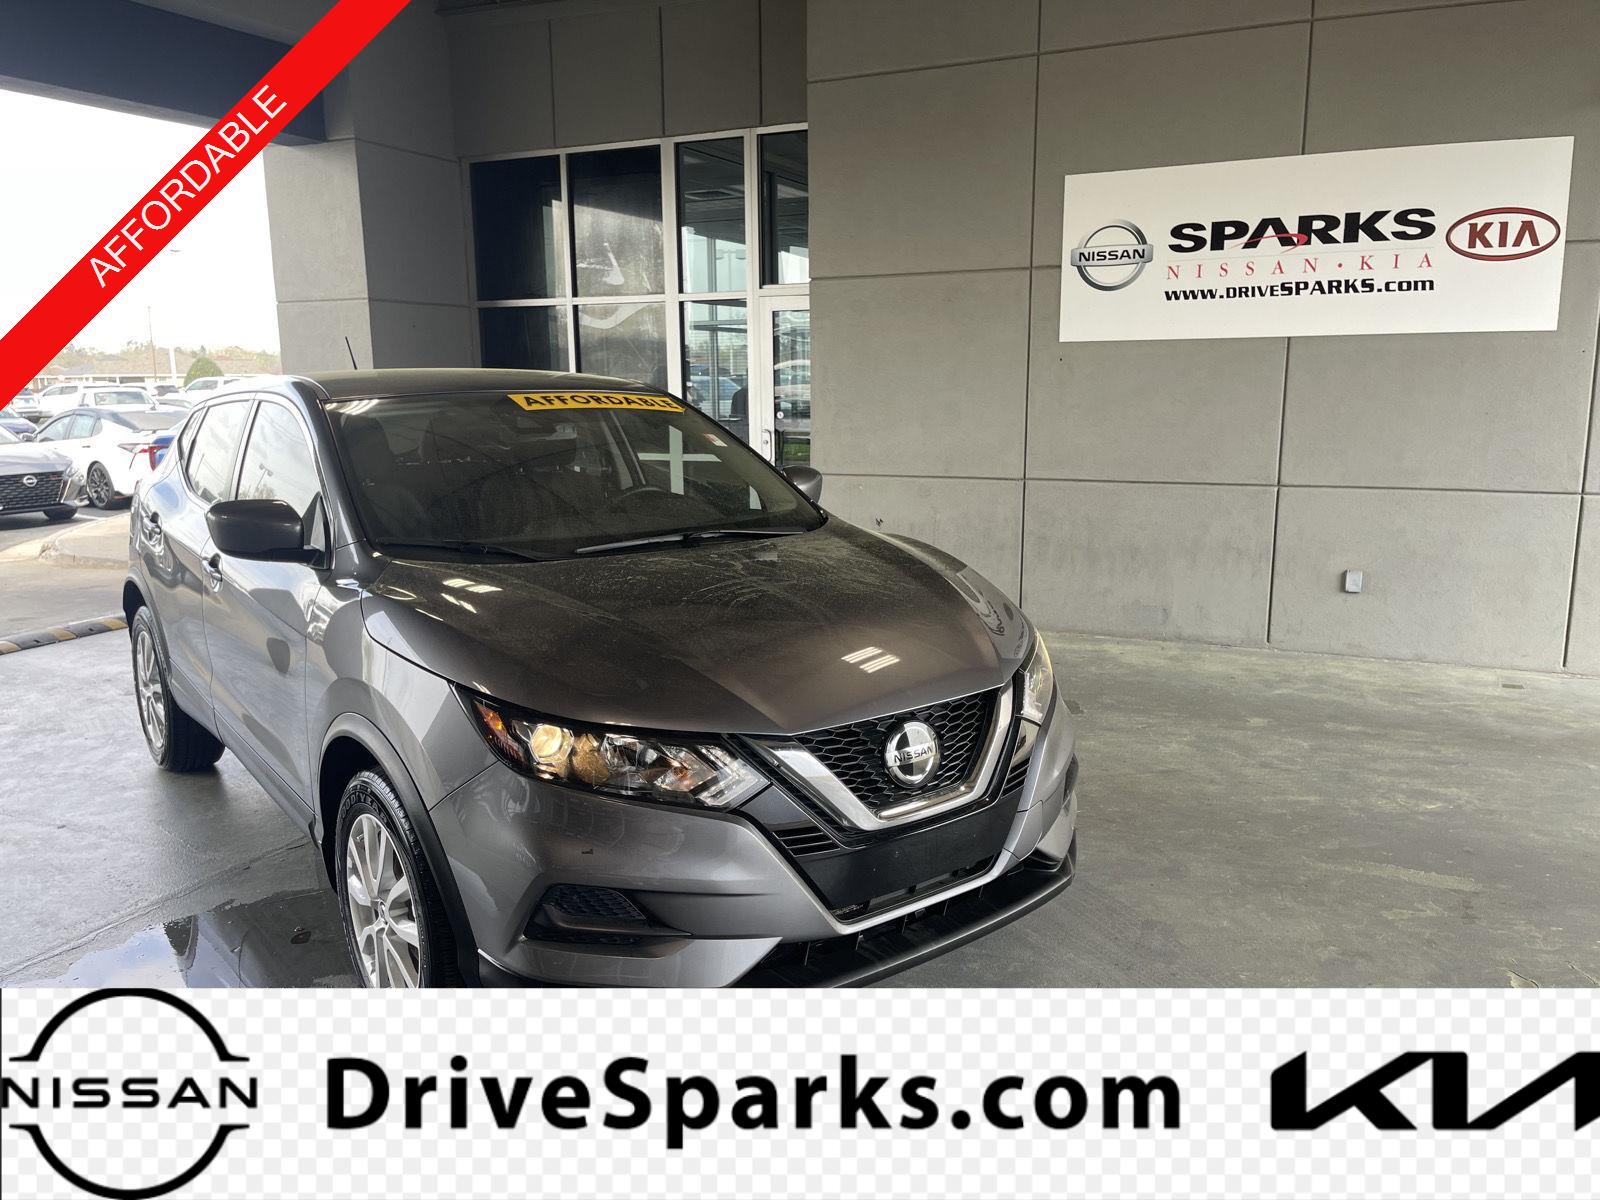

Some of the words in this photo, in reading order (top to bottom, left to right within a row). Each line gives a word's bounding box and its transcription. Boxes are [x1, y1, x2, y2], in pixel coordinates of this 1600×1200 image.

[1168, 208, 1436, 253] SPARKS
[1468, 220, 1541, 249] KIA
[1078, 248, 1146, 262] NISSAN
[524, 394, 679, 410] AFFORDABLE
[894, 745, 933, 763] NISSAN
